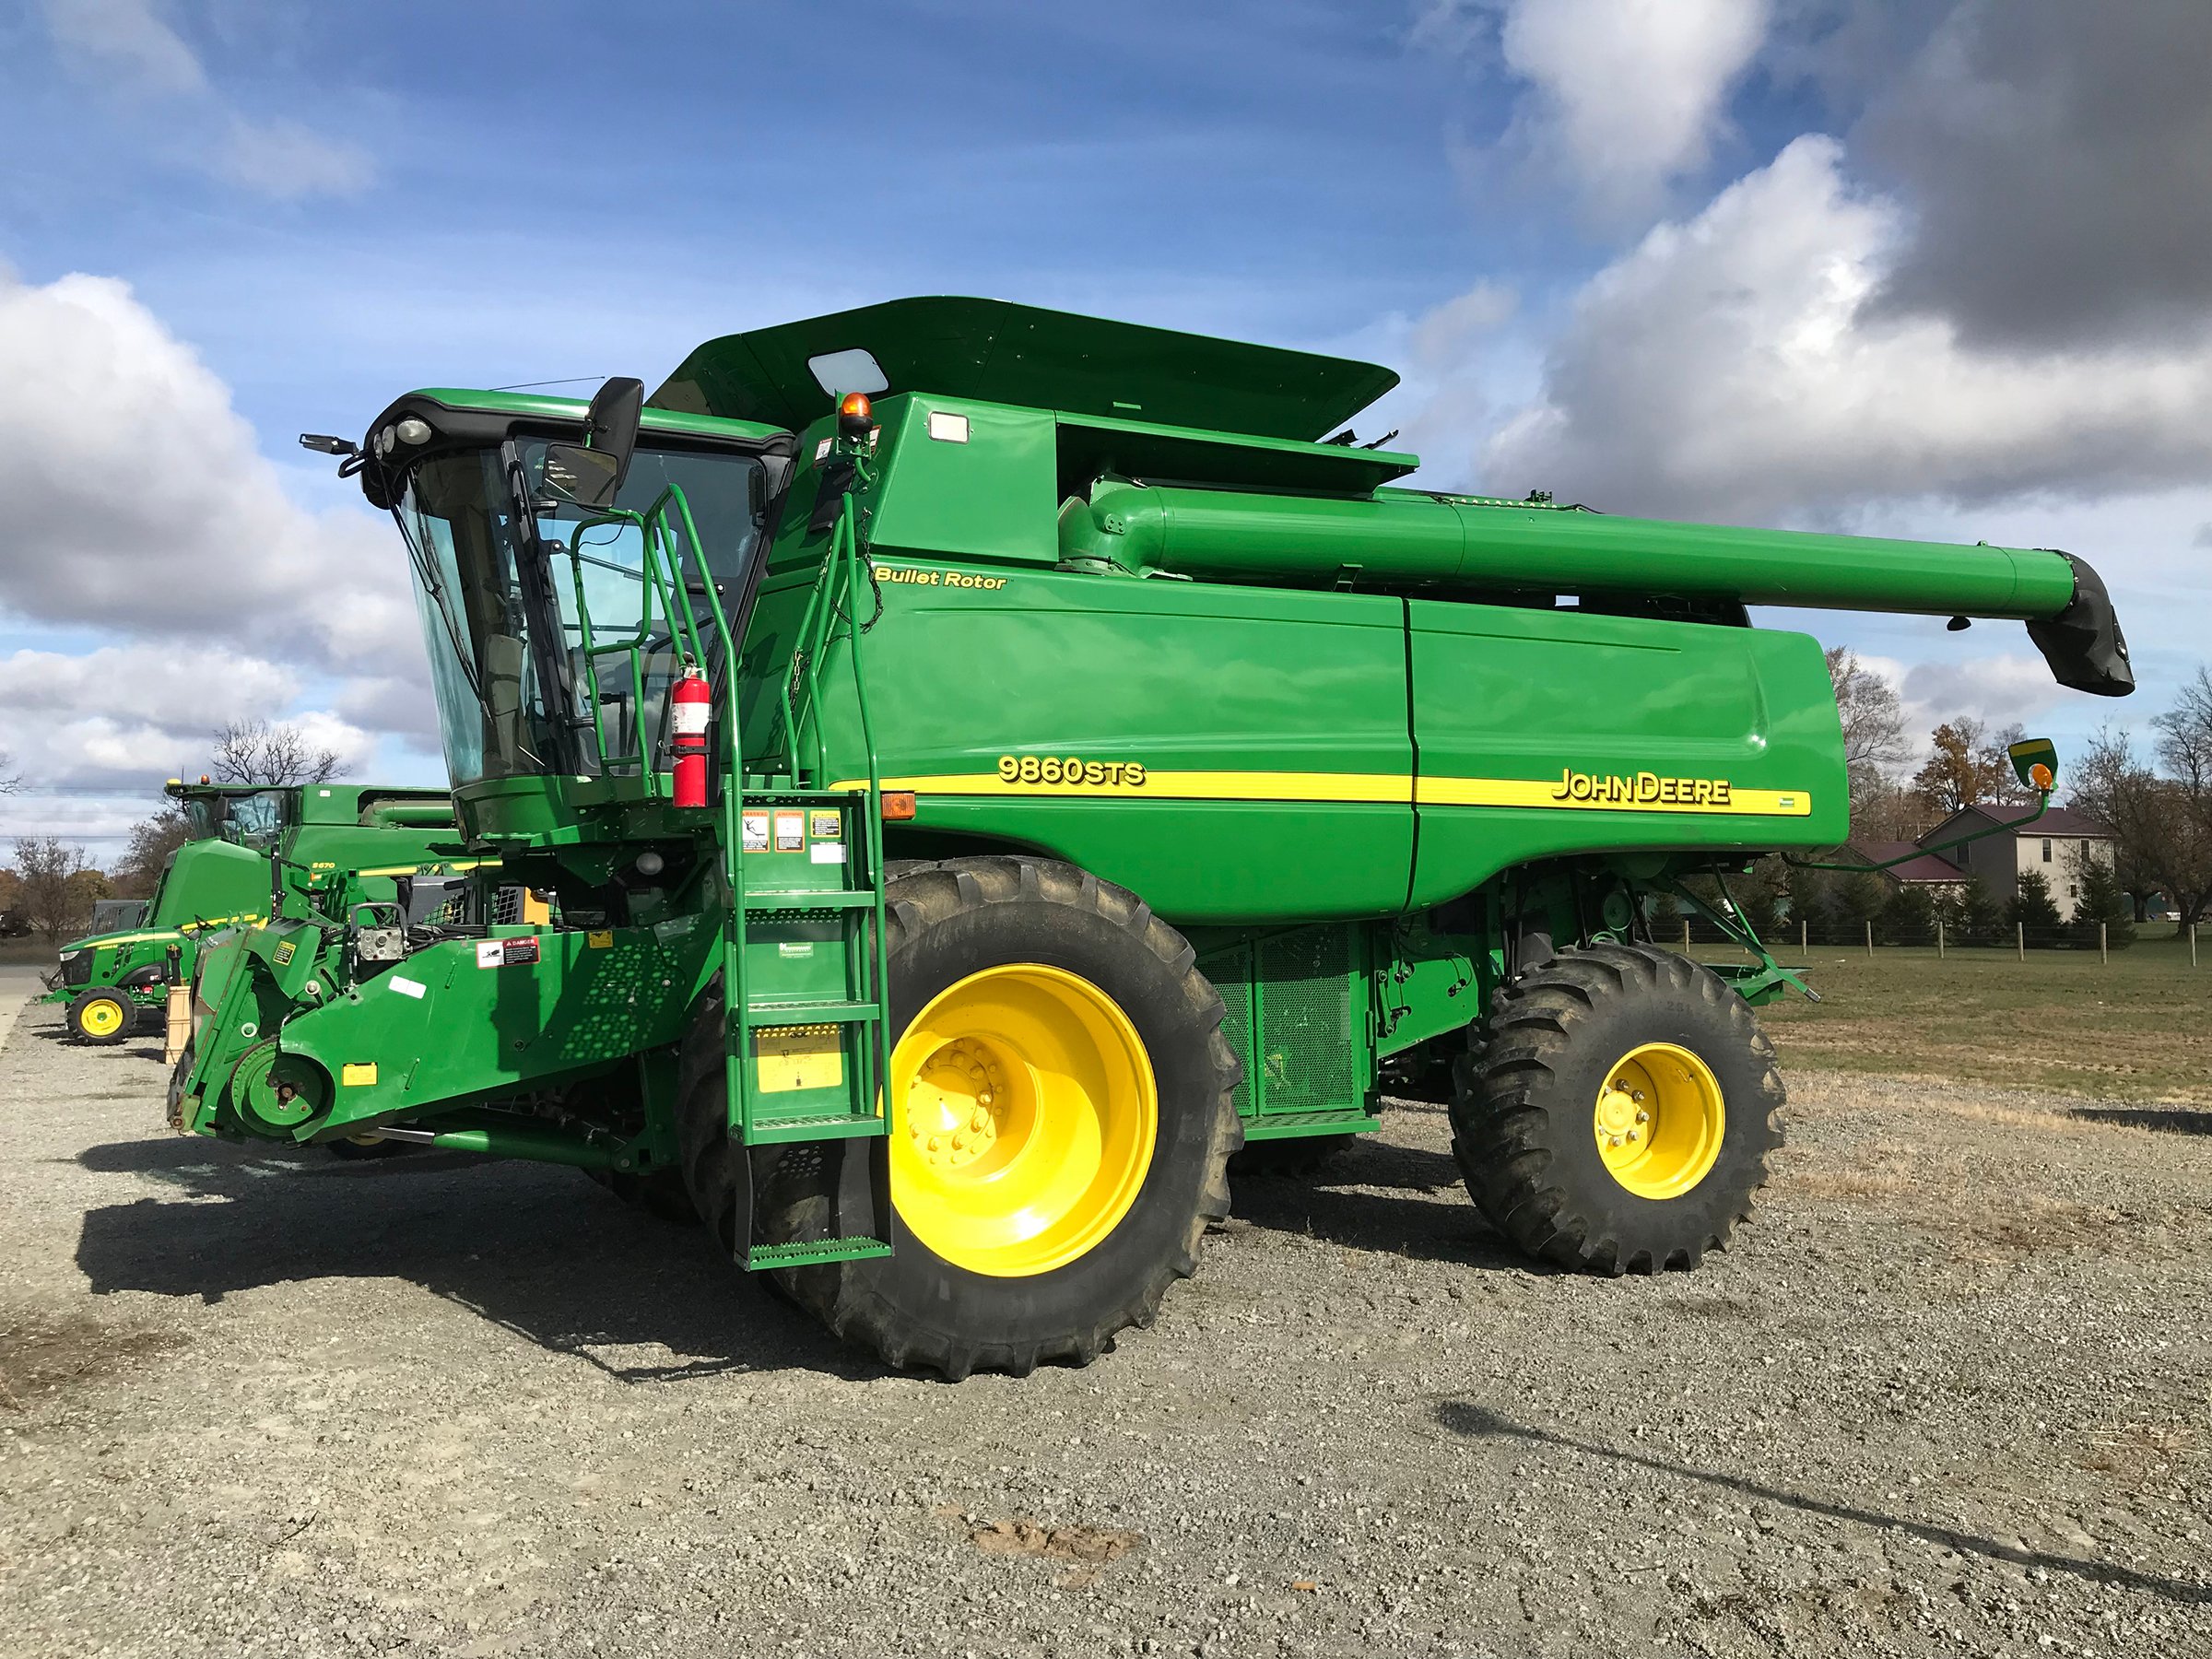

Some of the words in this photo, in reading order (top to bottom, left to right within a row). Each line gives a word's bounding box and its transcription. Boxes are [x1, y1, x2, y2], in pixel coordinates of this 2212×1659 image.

[875, 567, 940, 586] Bullet
[943, 571, 1008, 591] Rotor
[998, 755, 1147, 786] 9860STS
[1551, 768, 1636, 805] JOHN
[1637, 771, 1731, 807] DEERE
